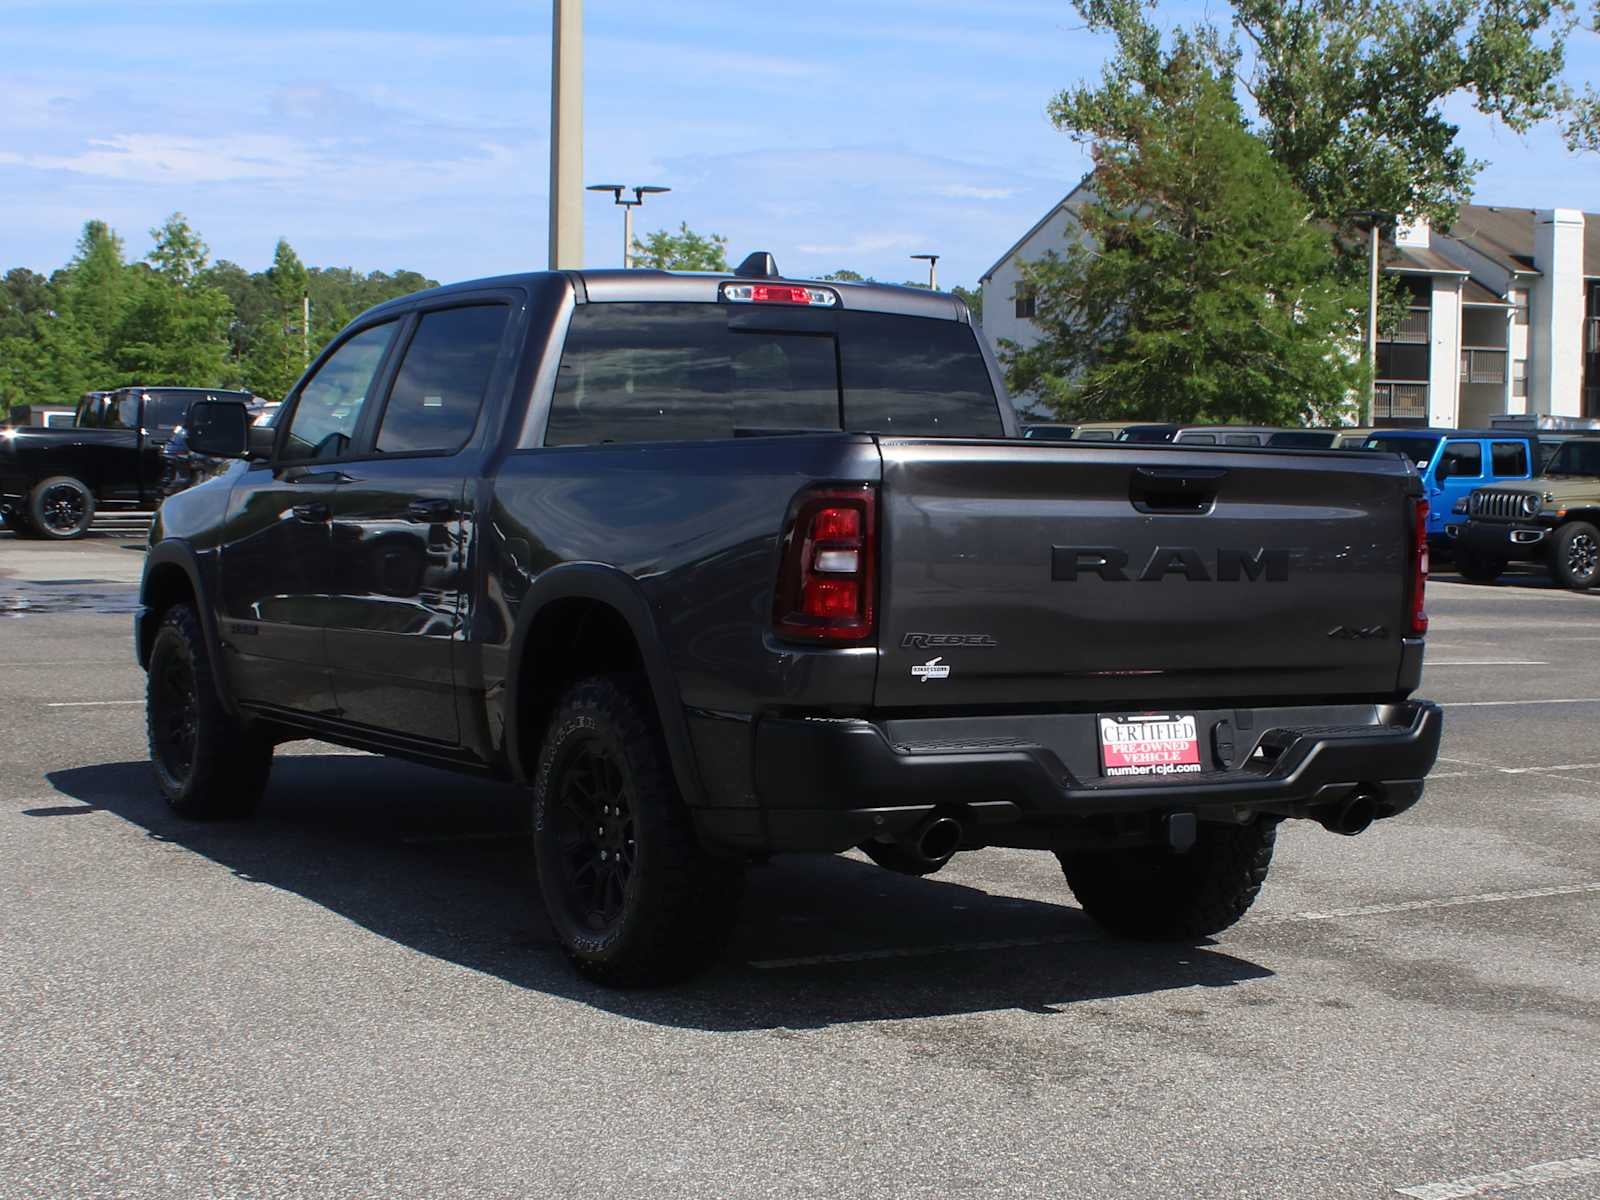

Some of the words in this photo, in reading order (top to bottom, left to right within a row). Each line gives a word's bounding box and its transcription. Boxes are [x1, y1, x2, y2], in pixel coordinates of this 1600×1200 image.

[1051, 544, 1289, 582] RAM
[901, 632, 998, 649] REBEL
[1103, 722, 1195, 742] CERTIFIED
[1111, 740, 1189, 754] PRE-OWNED
[1123, 751, 1182, 762] VEHICLE
[1107, 764, 1201, 776] number1cjd.com
